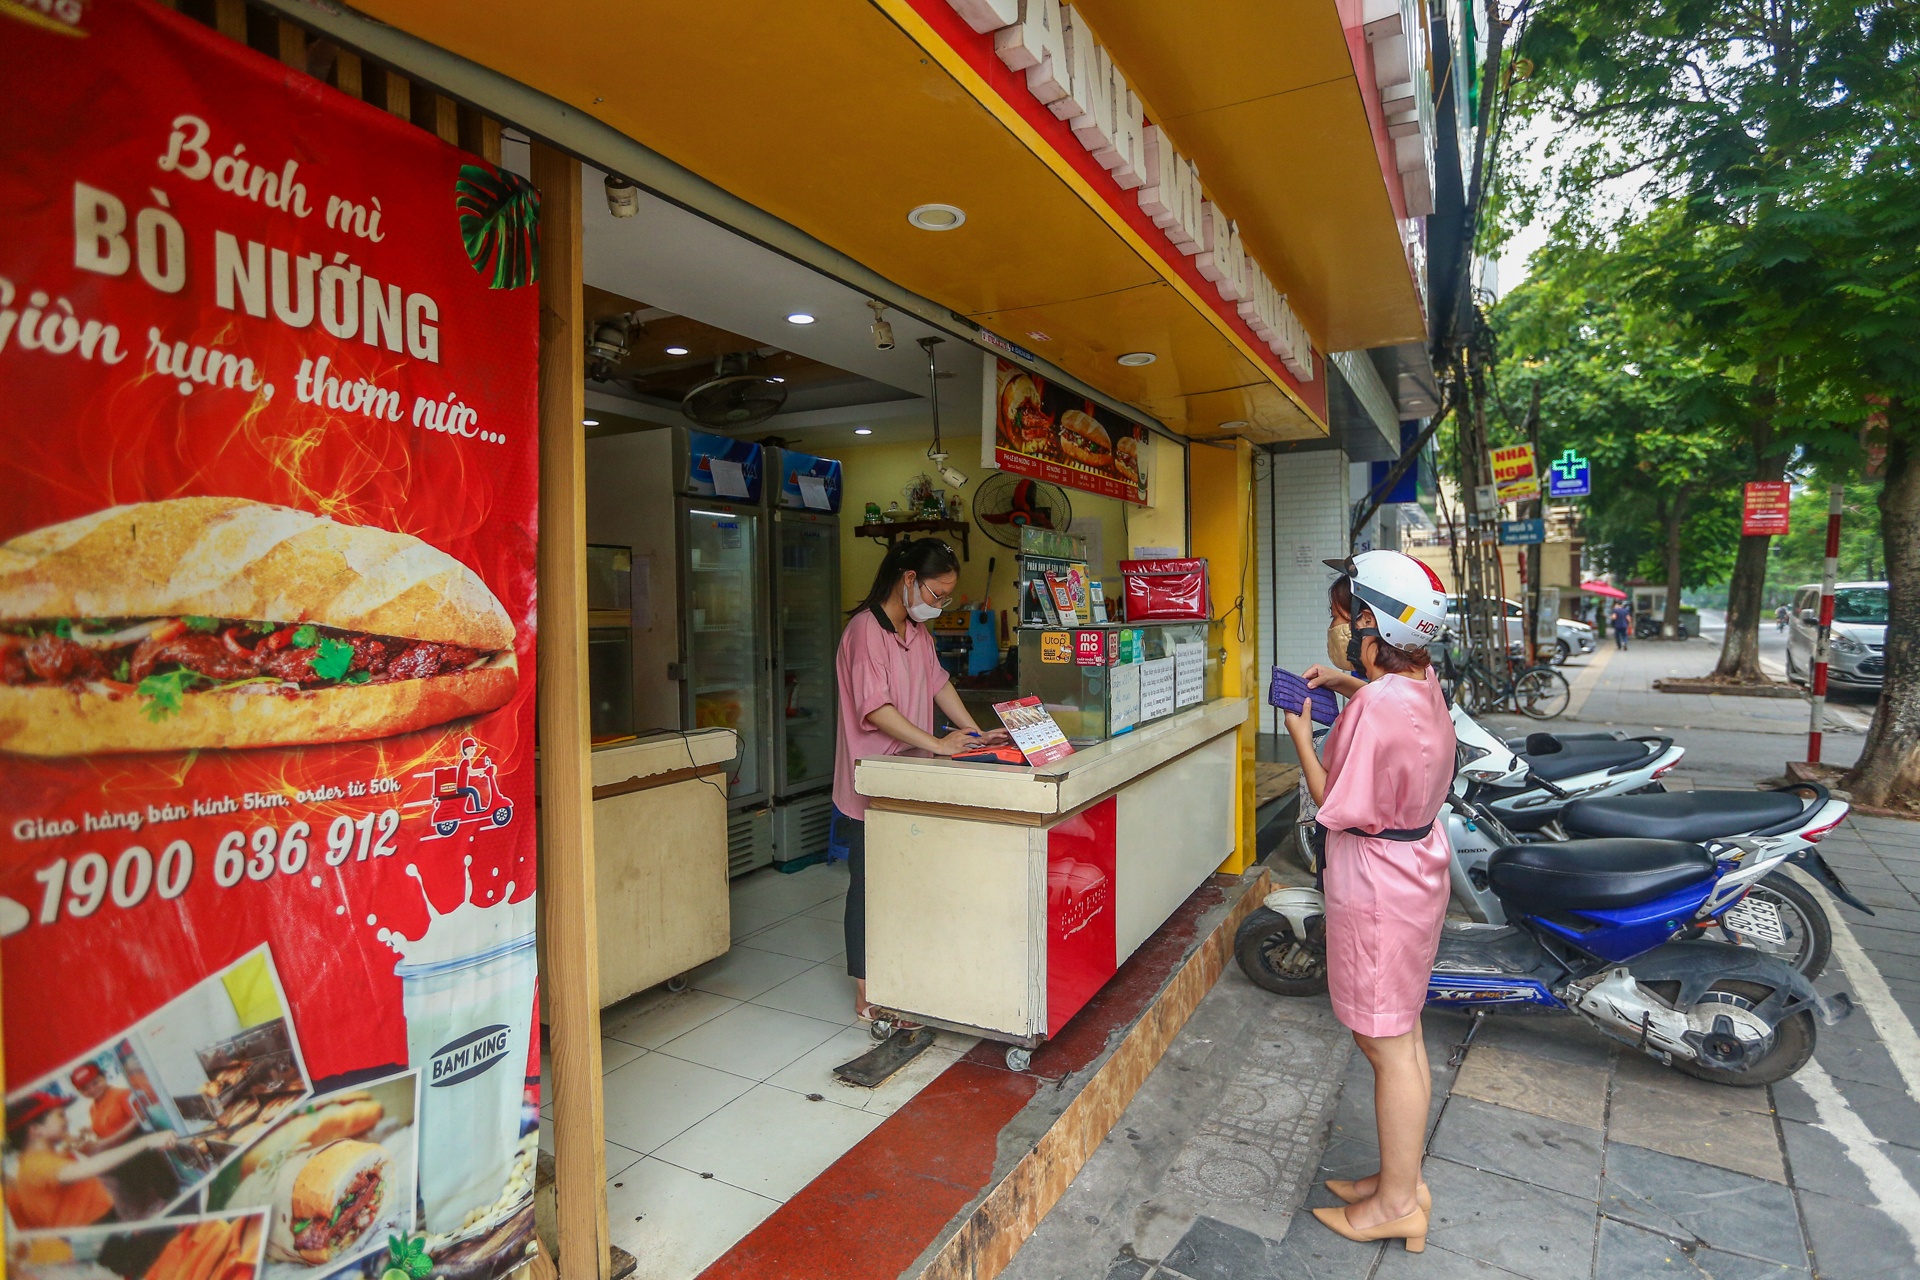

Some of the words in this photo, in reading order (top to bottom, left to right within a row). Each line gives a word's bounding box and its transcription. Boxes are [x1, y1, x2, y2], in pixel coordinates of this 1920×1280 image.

[157, 114, 313, 219] Bánh
[325, 195, 386, 243] mì
[73, 180, 187, 294] BÒ
[214, 229, 440, 364] NƯỚNG
[145, 325, 276, 401] rụm,
[295, 355, 404, 423] thơm
[12, 810, 79, 841] Giao
[84, 806, 145, 833] hàng
[147, 801, 189, 823] bán
[193, 794, 240, 819] kính
[296, 784, 346, 805] order
[347, 780, 367, 798] từ
[370, 777, 402, 795] 50k
[34, 838, 195, 927] 1900
[213, 820, 311, 889] 636
[324, 808, 402, 867] 912
[433, 1048, 470, 1080] BAMI
[473, 1032, 506, 1063] KING
